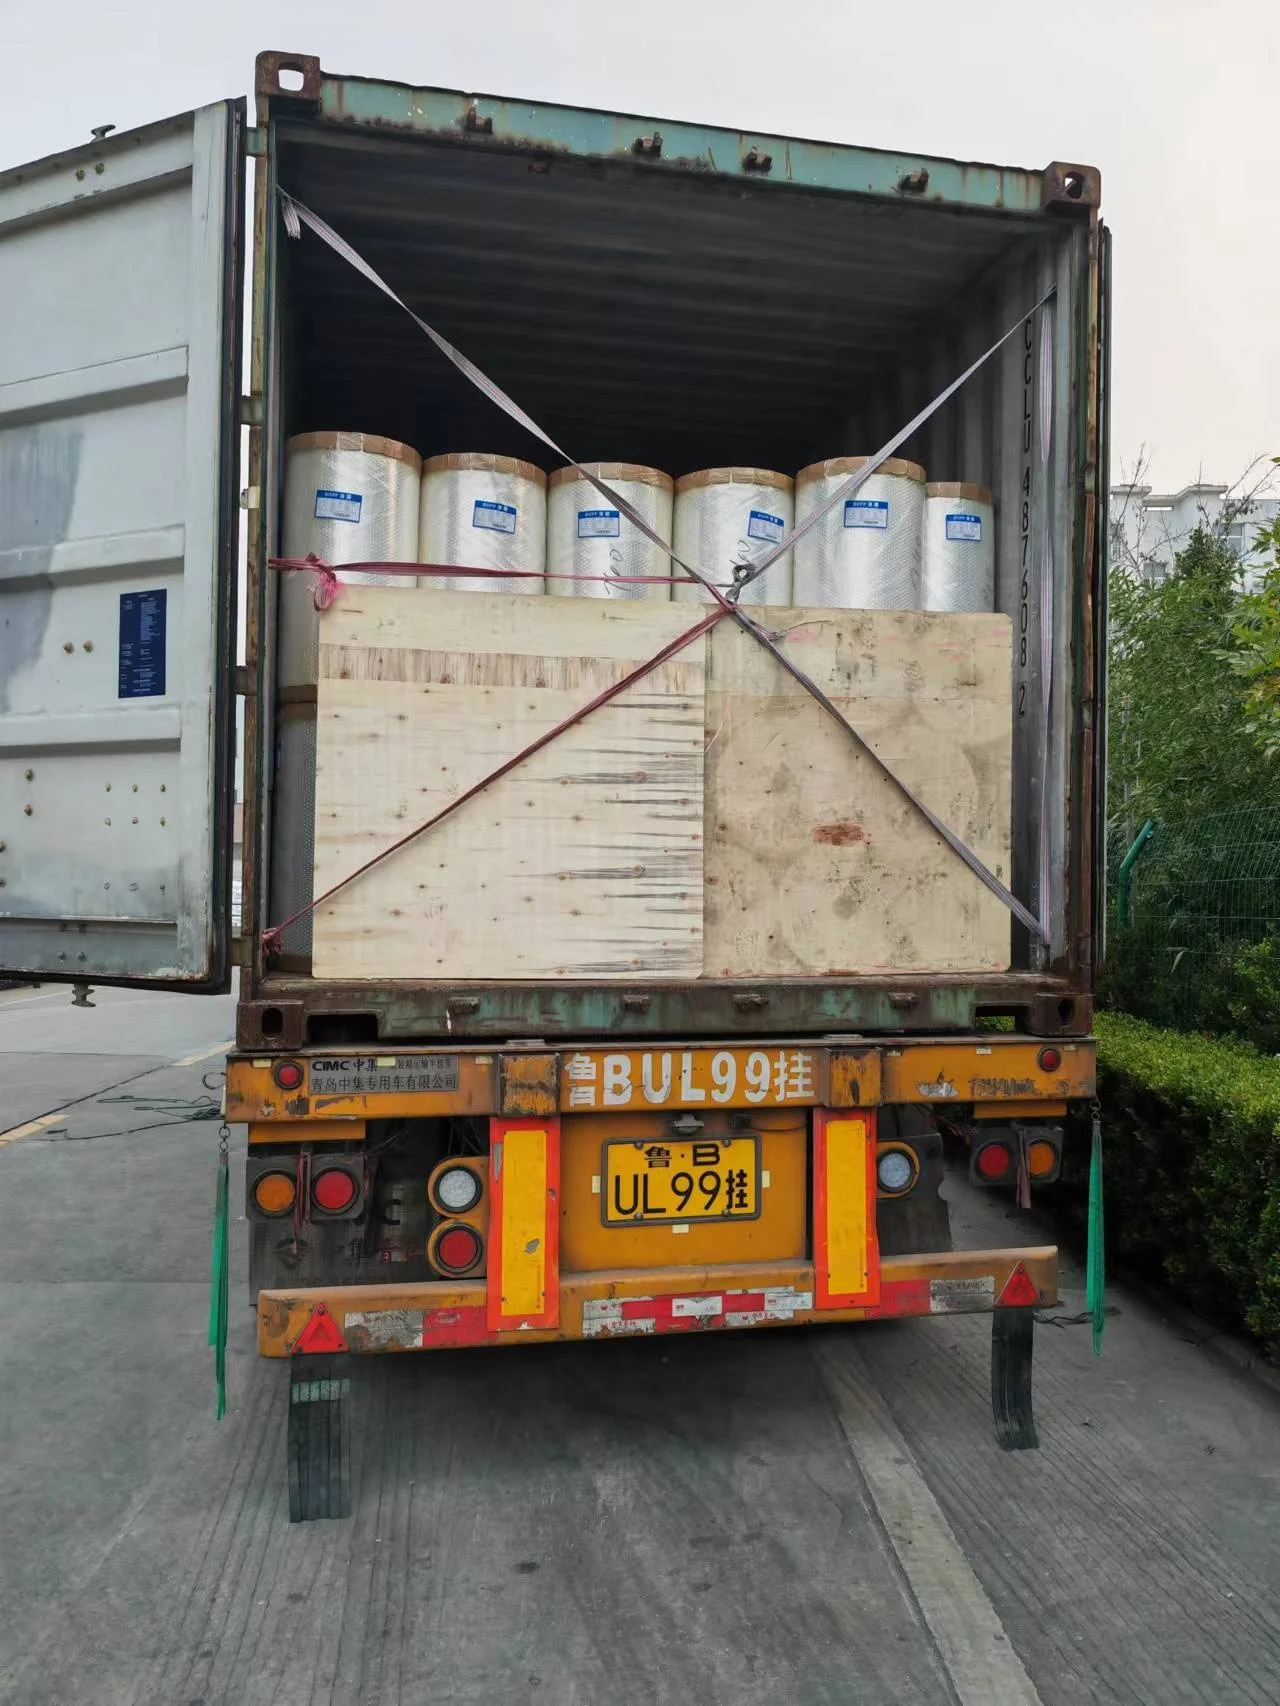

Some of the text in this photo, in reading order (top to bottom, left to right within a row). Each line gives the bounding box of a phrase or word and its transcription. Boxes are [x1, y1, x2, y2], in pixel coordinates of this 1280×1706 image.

[1018, 318, 1032, 716] CCLU 487608 2
[312, 1060, 350, 1071] CIMC
[353, 1058, 377, 1072] 中集
[312, 1074, 457, 1092] 青岛中集专用车有限公司
[564, 1050, 815, 1106] 鲁BUL99挂
[614, 1169, 748, 1215] UL99挂
